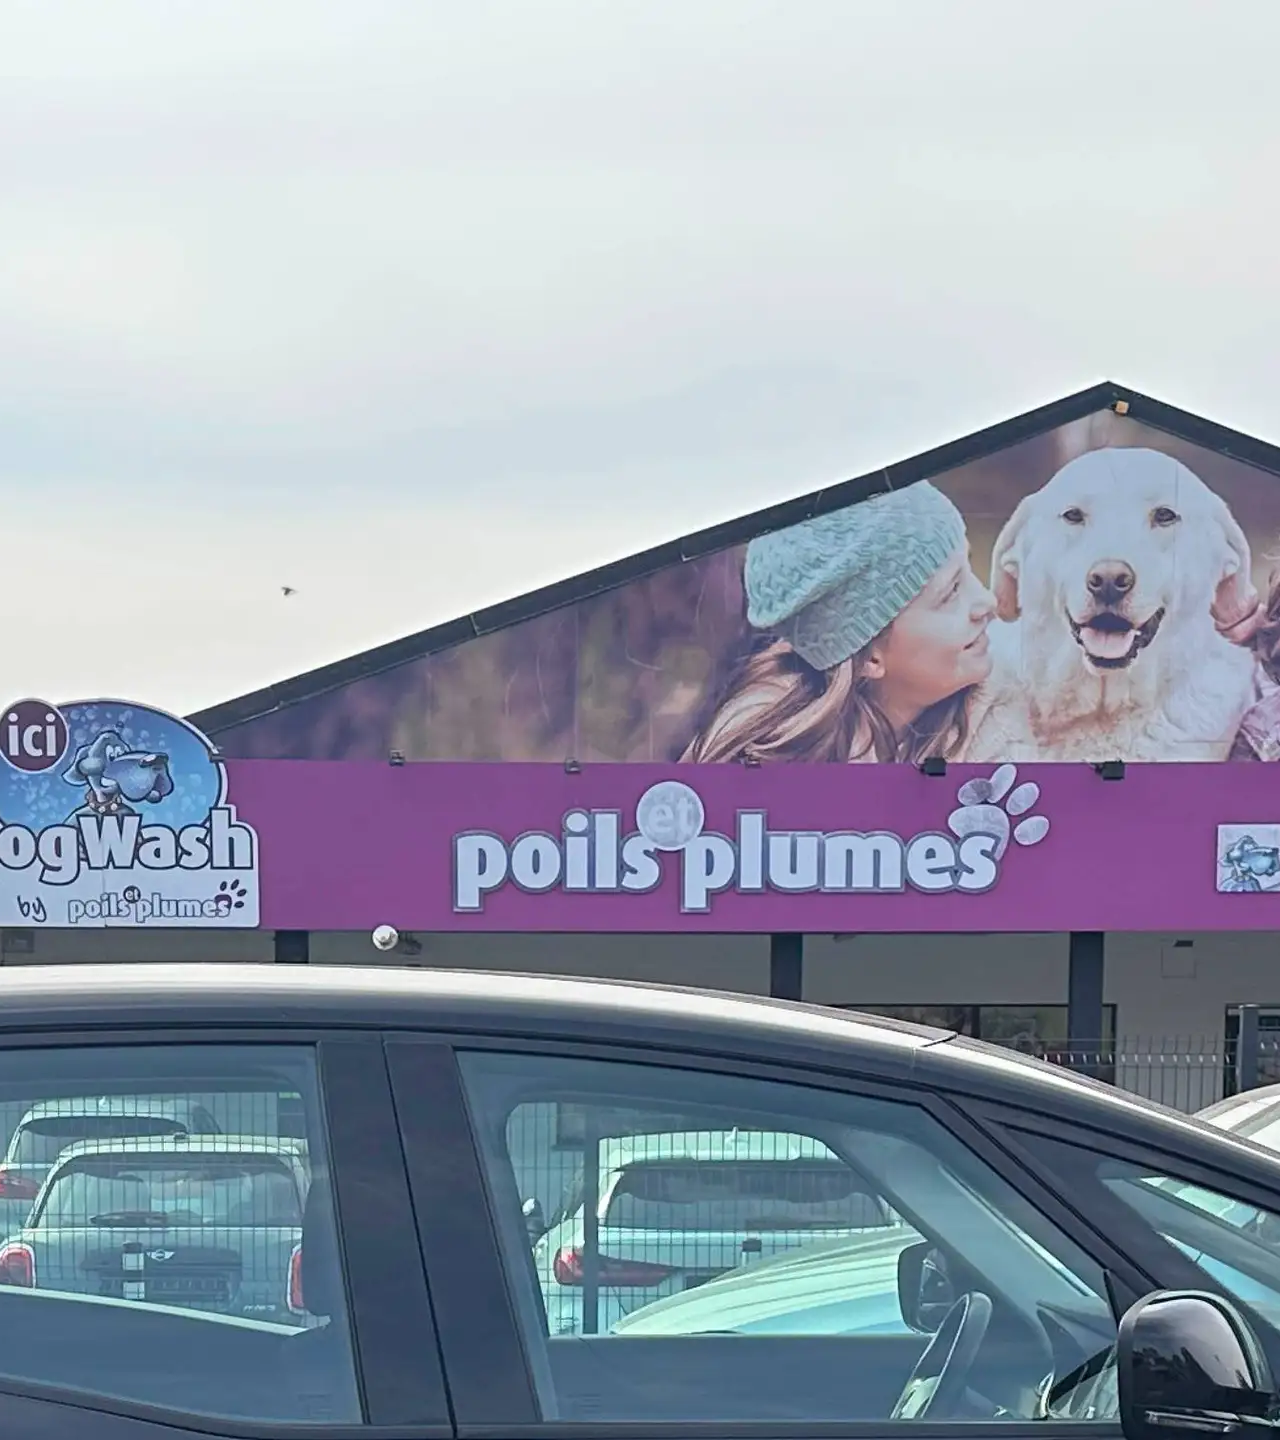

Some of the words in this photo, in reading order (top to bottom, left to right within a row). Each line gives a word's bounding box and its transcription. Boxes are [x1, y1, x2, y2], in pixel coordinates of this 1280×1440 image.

[7, 712, 57, 757] ici
[453, 808, 660, 914] poils
[680, 808, 1001, 914] plumes
[17, 894, 48, 923] by
[68, 892, 131, 923] poils
[135, 892, 232, 923] plumes
